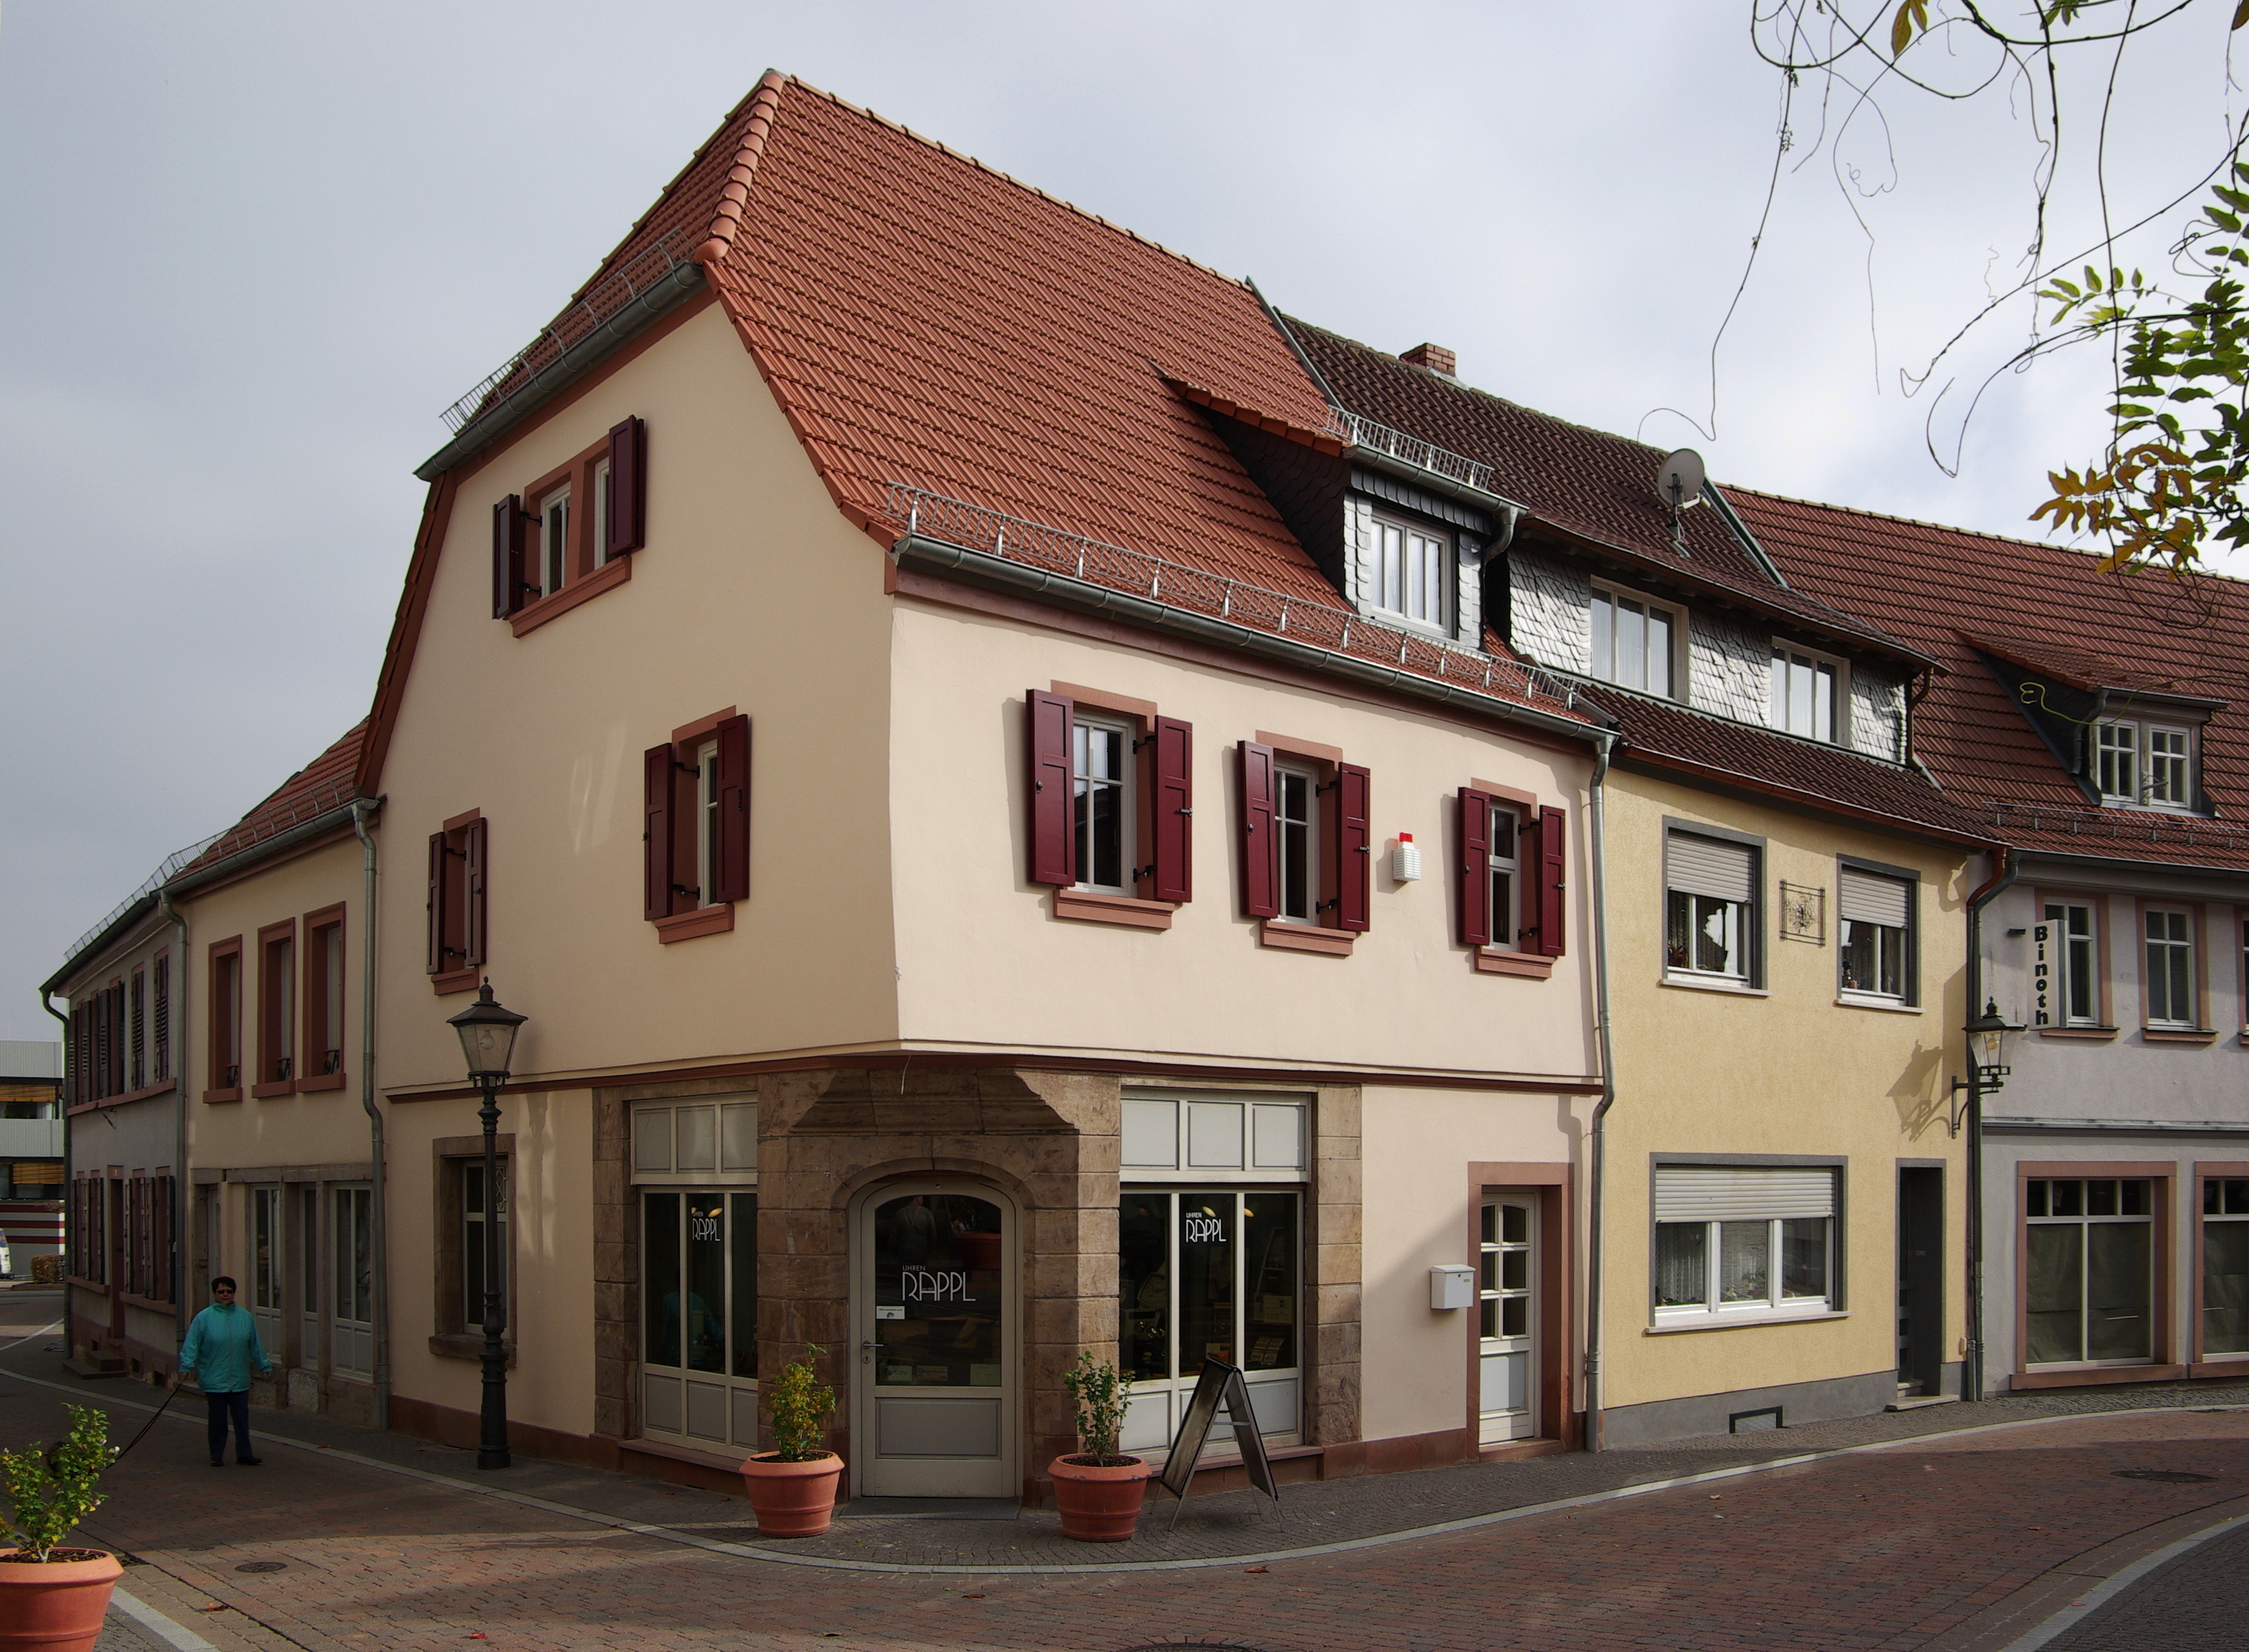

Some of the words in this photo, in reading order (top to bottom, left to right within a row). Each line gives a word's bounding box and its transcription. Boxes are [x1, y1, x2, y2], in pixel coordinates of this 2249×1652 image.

[2034, 926, 2048, 1025] Binoth
[692, 1218, 720, 1241] RAPPL
[1186, 1219, 1226, 1242] RAPPL
[902, 1271, 976, 1301] RAPPL
